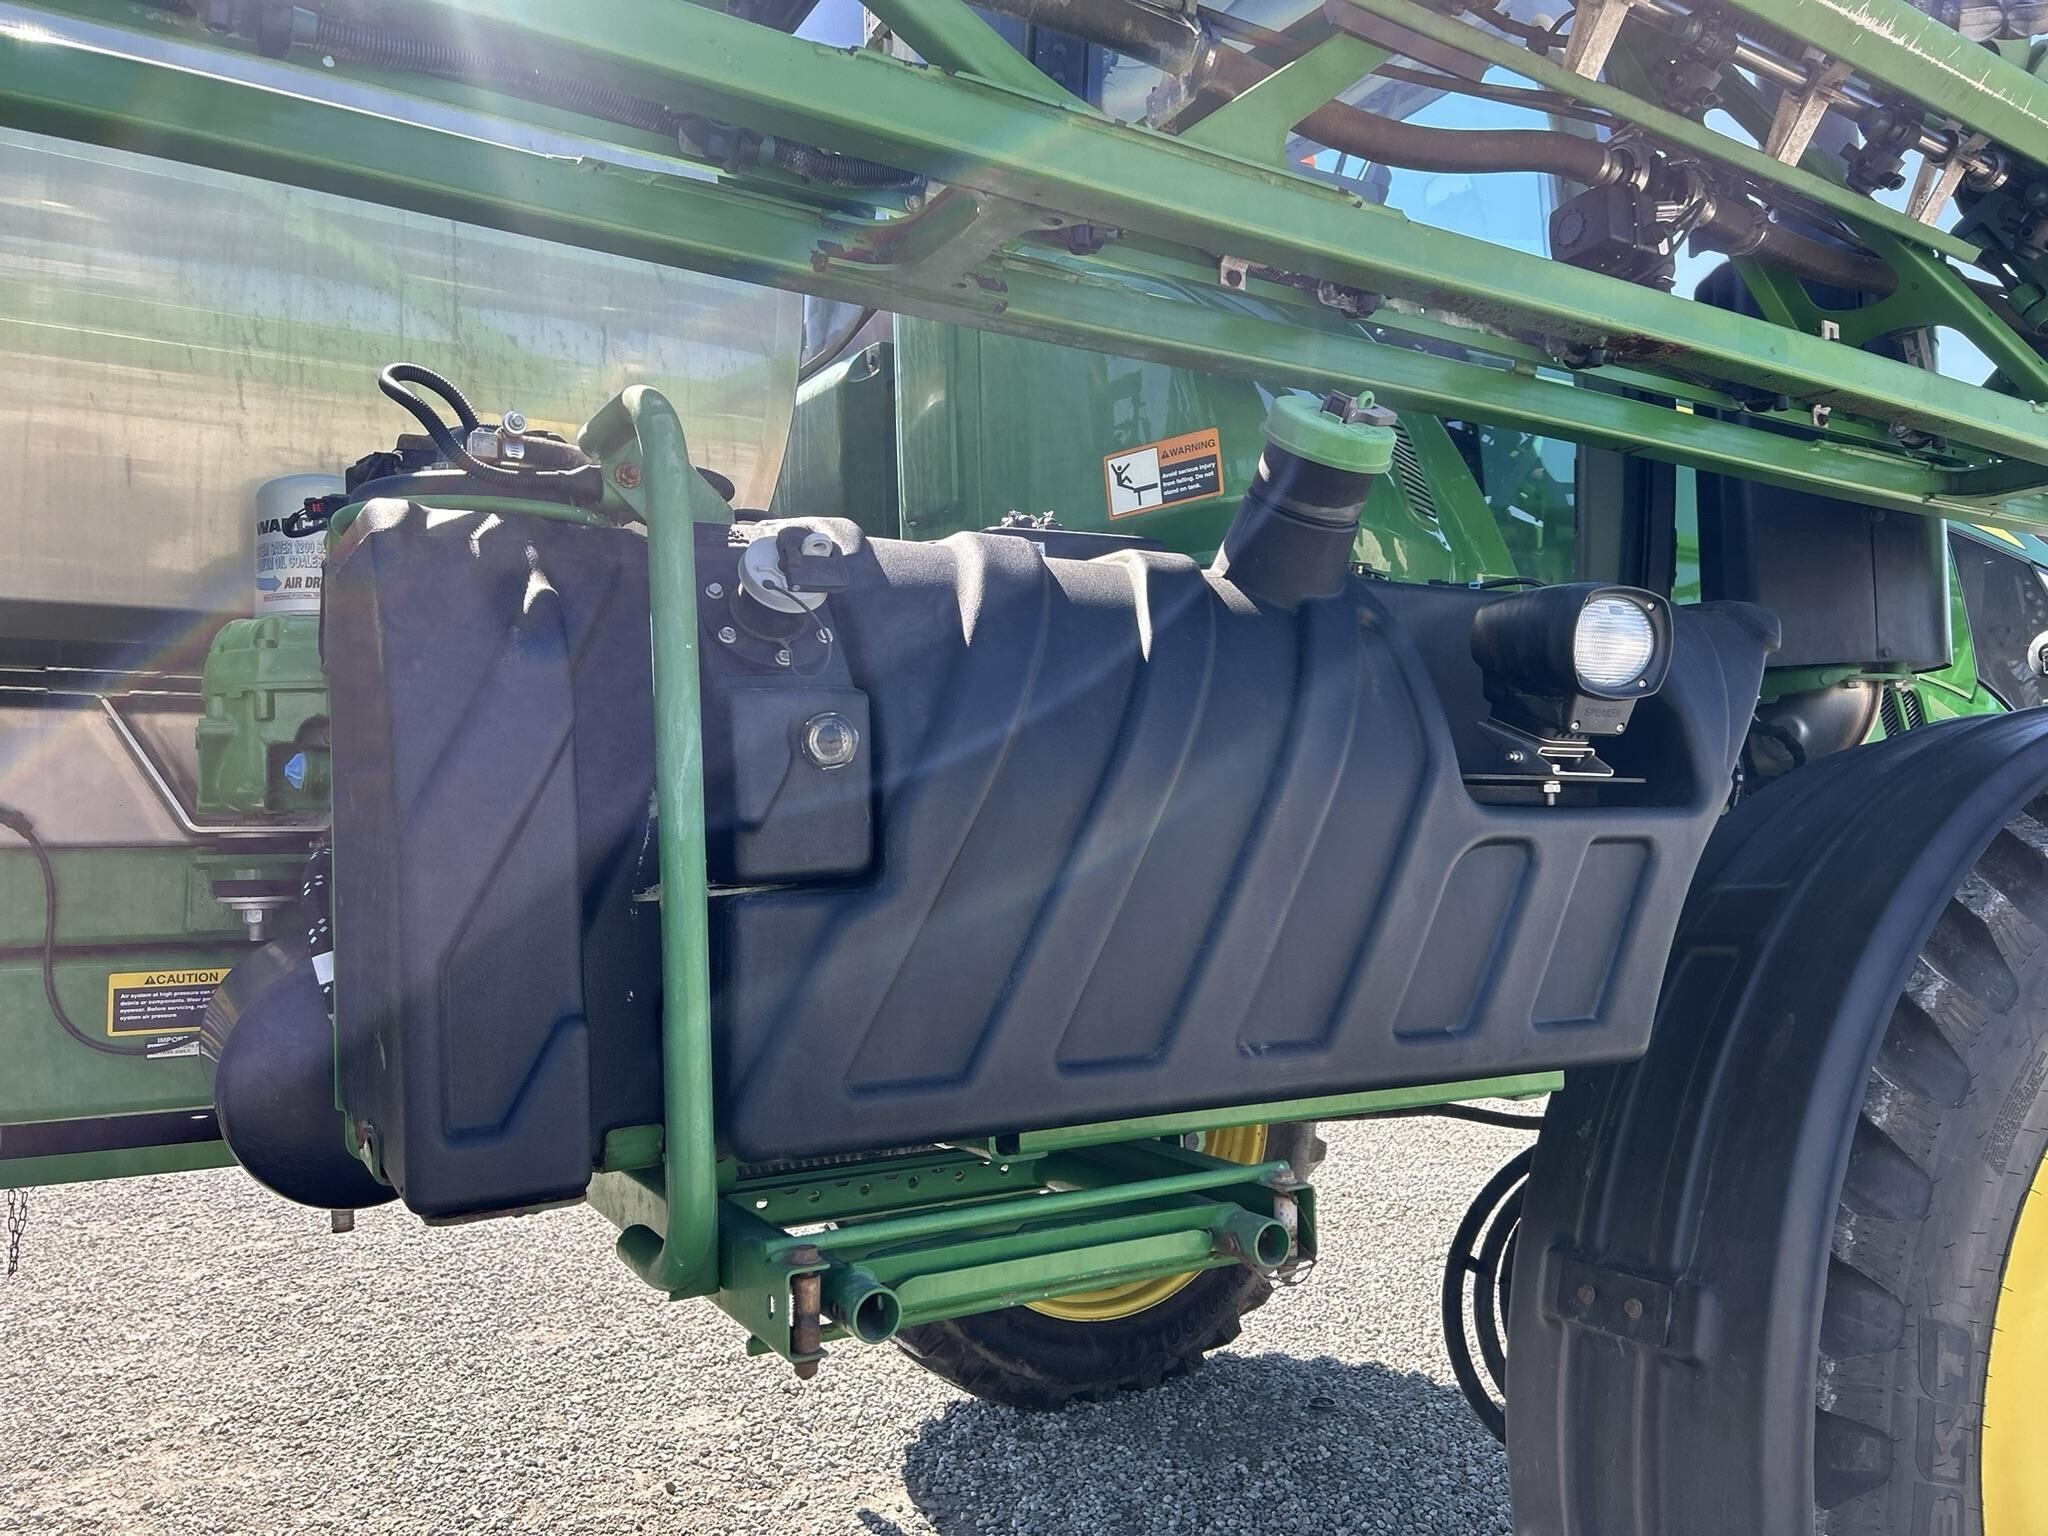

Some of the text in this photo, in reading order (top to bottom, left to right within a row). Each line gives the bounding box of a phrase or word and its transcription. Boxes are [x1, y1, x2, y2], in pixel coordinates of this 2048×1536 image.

[1170, 438, 1216, 457] WARNING
[1162, 462, 1216, 479] Avoid serious injury
[1162, 480, 1176, 488] from
[1163, 487, 1179, 496] stand
[294, 539, 316, 554] 1200
[284, 576, 322, 589] AIR DR
[156, 972, 218, 985] CAUTION
[130, 992, 152, 1000] system
